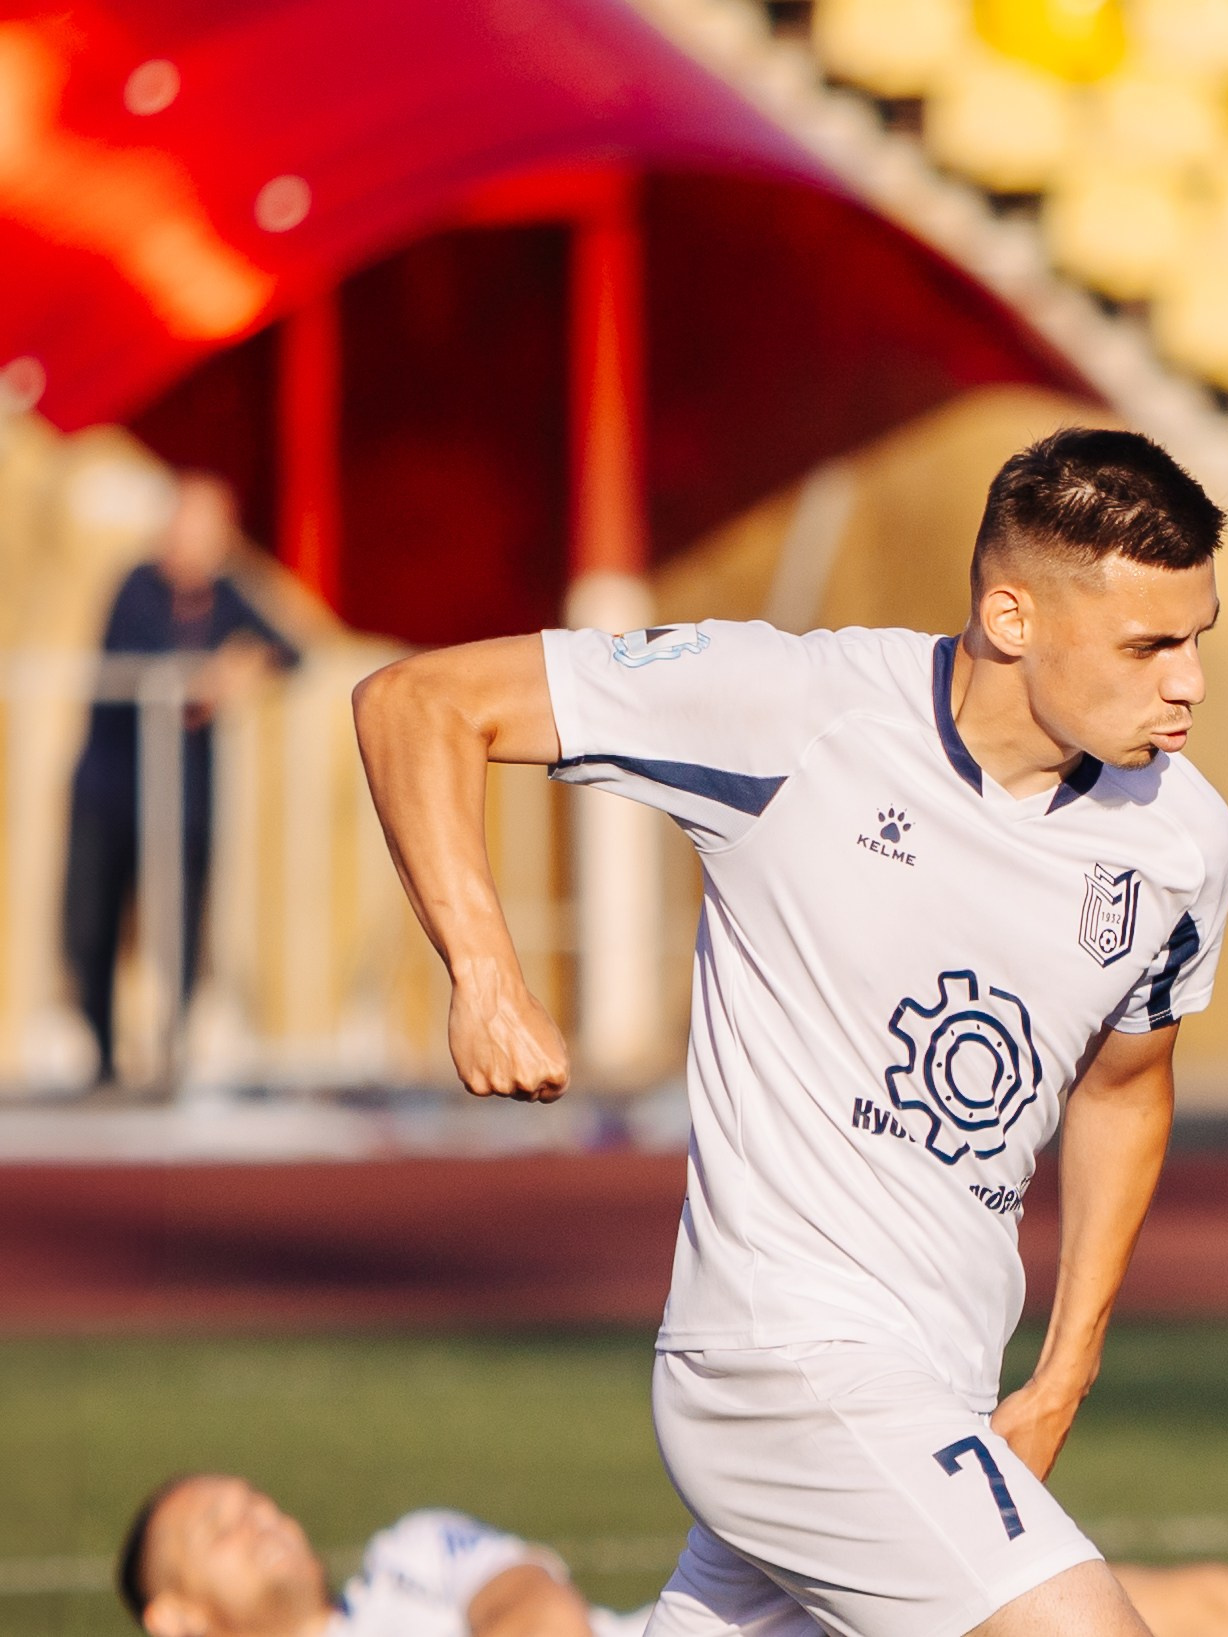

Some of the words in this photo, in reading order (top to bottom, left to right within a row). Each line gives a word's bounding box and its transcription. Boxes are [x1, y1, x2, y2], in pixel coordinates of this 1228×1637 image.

[856, 833, 917, 867] KELME
[1101, 911, 1122, 925] 1932
[931, 1434, 1026, 1542] 7
